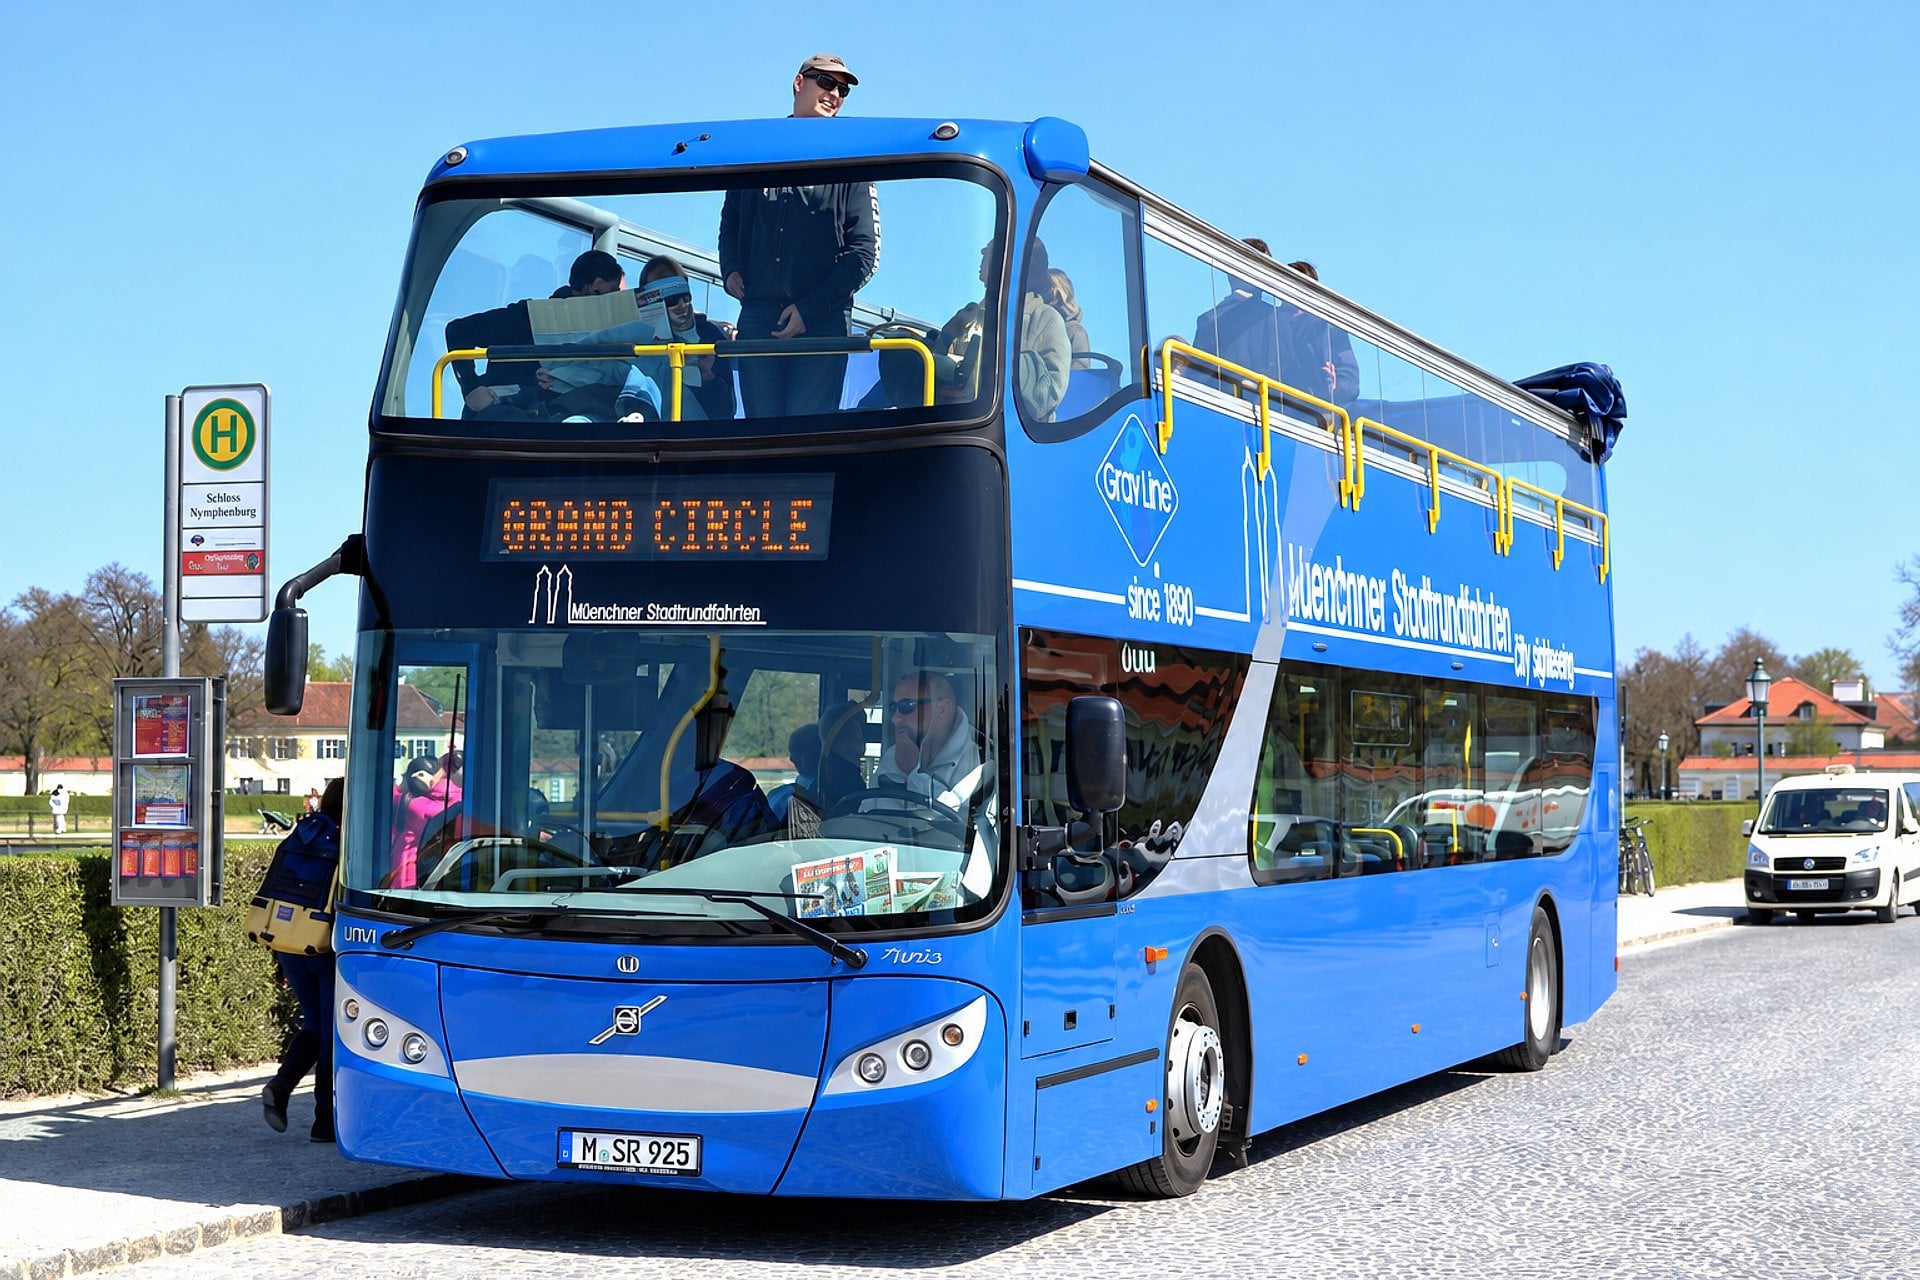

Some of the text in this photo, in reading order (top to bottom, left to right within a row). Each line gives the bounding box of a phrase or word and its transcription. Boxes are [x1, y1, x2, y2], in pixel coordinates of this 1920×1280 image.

[210, 414, 238, 453] H
[206, 492, 241, 504] Schloss
[1141, 470, 1173, 513] Line
[190, 506, 257, 520] Nymphenburg
[502, 499, 813, 551] GRAND CIRCLE
[646, 602, 761, 622] Stadtrundfahrten
[1127, 576, 1194, 628] since 1890
[1391, 567, 1513, 654] Stadtrundfahrten
[582, 1136, 691, 1166] M SR 925
